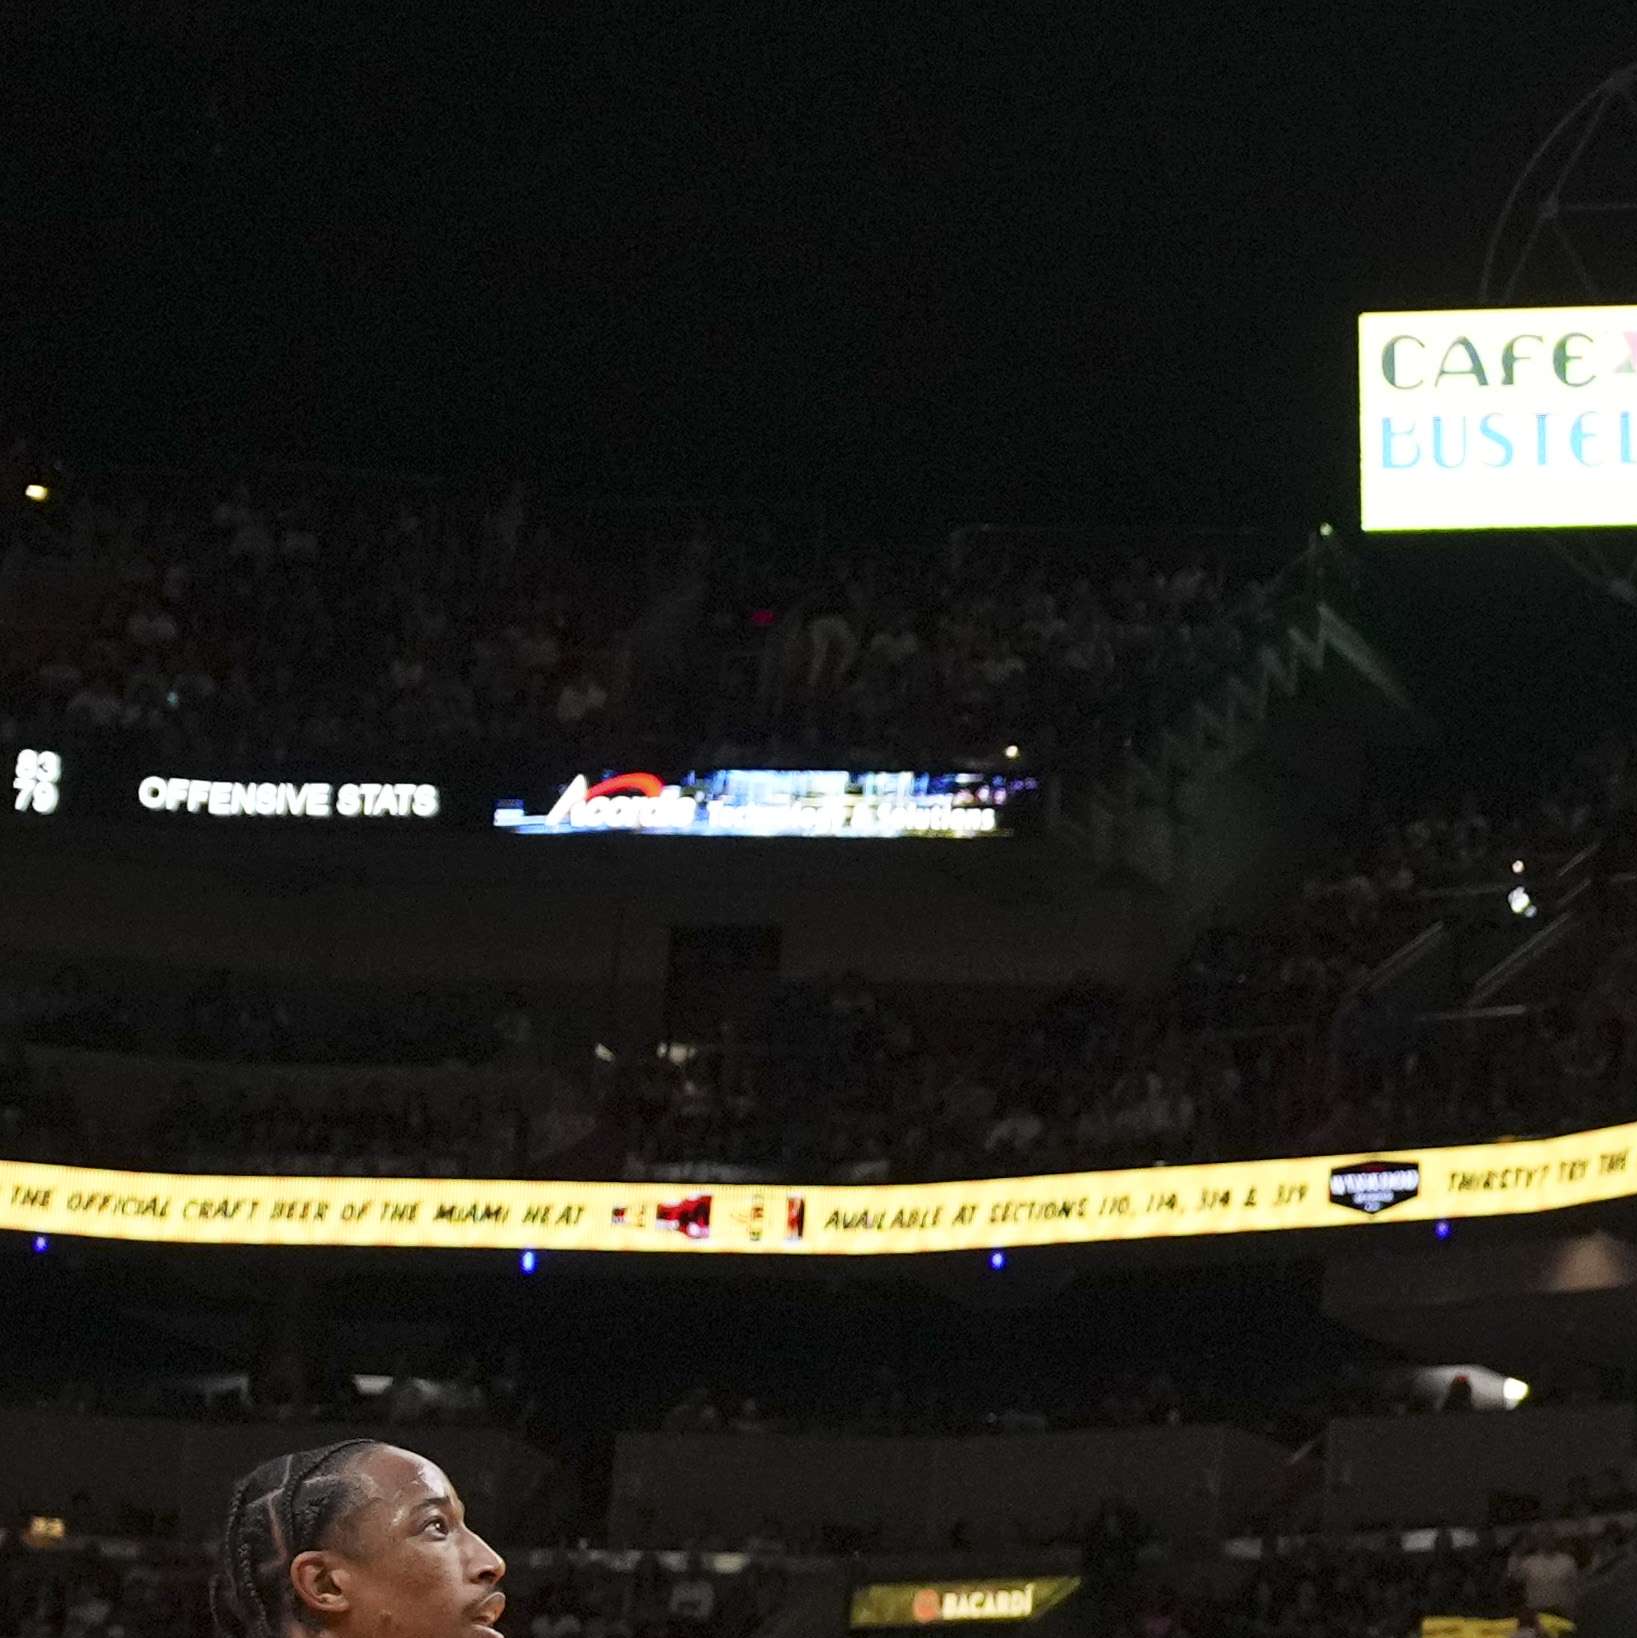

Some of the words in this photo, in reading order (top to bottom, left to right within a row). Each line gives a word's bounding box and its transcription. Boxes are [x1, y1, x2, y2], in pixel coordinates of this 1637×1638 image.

[1382, 332, 1597, 390] CAFE
[138, 776, 333, 817] OFFENSIVE
[337, 783, 439, 817] STATS
[10, 1183, 54, 1209] THE
[67, 1191, 172, 1220] OFFICIAL
[183, 1197, 260, 1222] CRAFT
[270, 1198, 327, 1222] BEER
[341, 1201, 368, 1223] OF
[381, 1201, 419, 1223] THE
[522, 1203, 587, 1227] HEAT
[825, 1203, 943, 1232] AVAILABLE
[951, 1203, 979, 1229] AT
[989, 1196, 1088, 1227] SECTIONS
